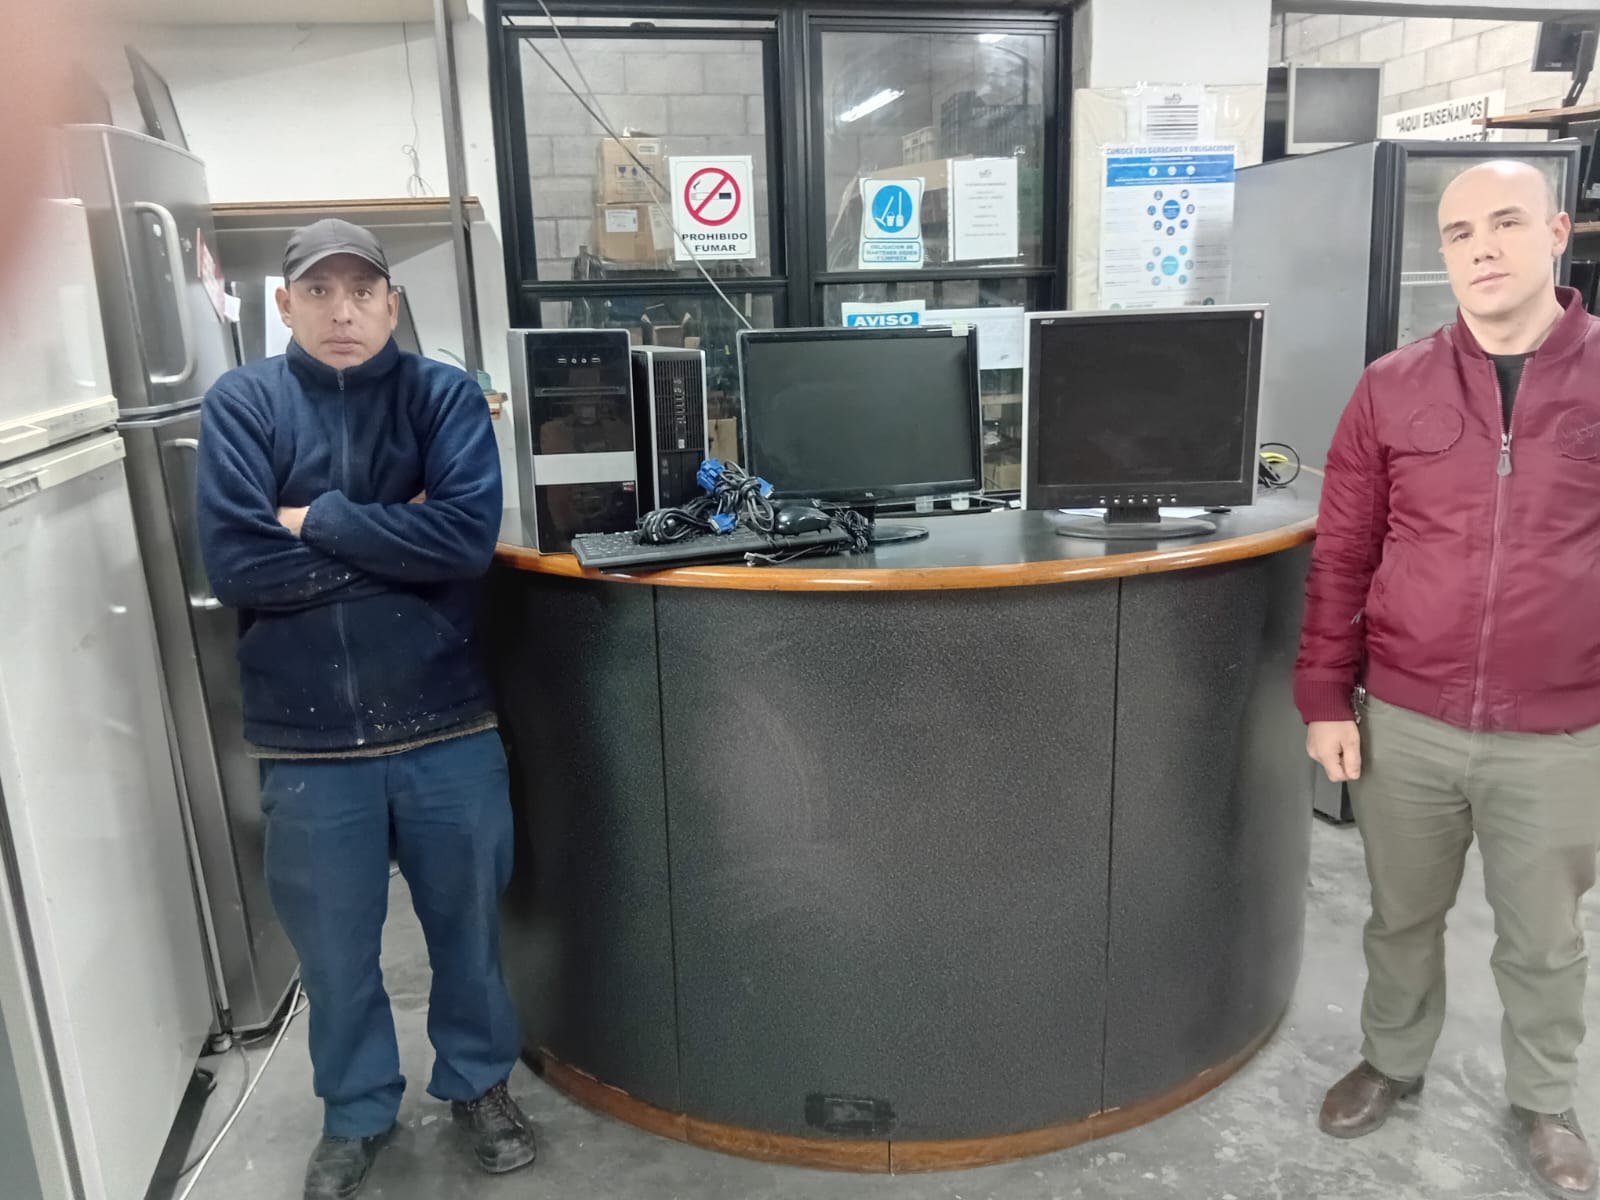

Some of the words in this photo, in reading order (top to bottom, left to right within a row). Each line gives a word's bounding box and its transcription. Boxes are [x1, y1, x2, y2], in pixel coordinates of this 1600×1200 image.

[1423, 101, 1483, 128] ENSEÑAMOS
[695, 244, 736, 252] FUMAR
[853, 314, 913, 327] AVISO
